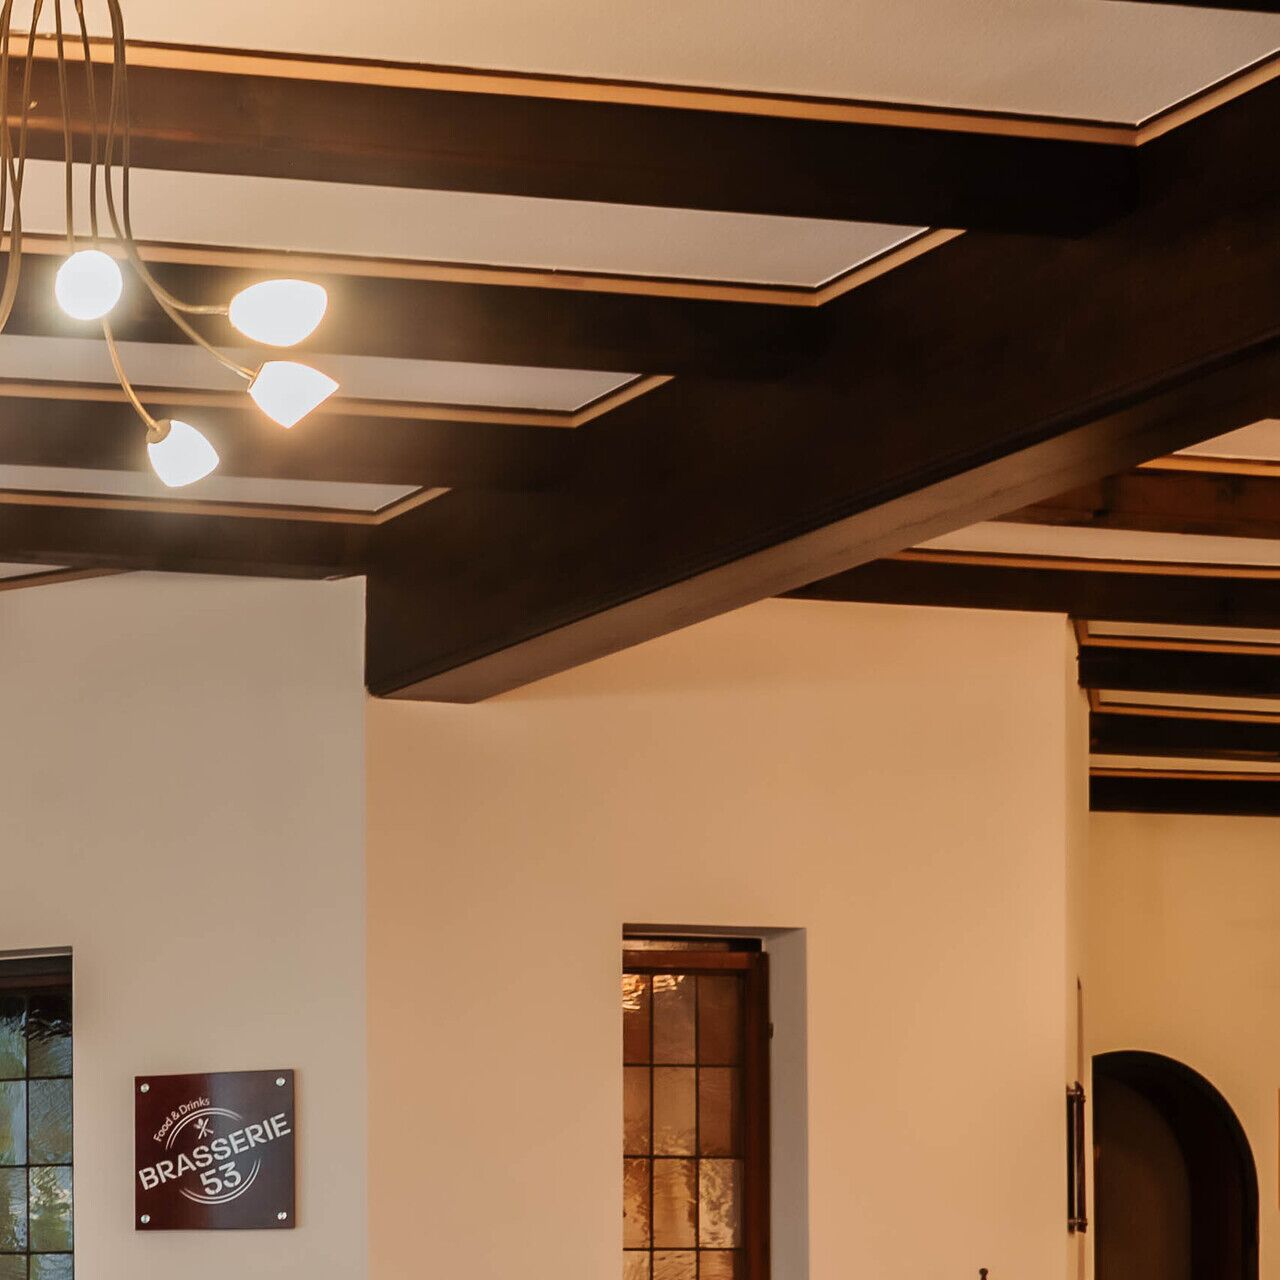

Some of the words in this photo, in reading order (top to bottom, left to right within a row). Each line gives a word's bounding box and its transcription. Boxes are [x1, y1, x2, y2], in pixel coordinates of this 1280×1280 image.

[153, 1117, 174, 1143] Food
[171, 1111, 180, 1121] &
[179, 1096, 211, 1115] Drinks
[138, 1112, 292, 1191] BRASSERIE
[199, 1161, 243, 1196] 53
